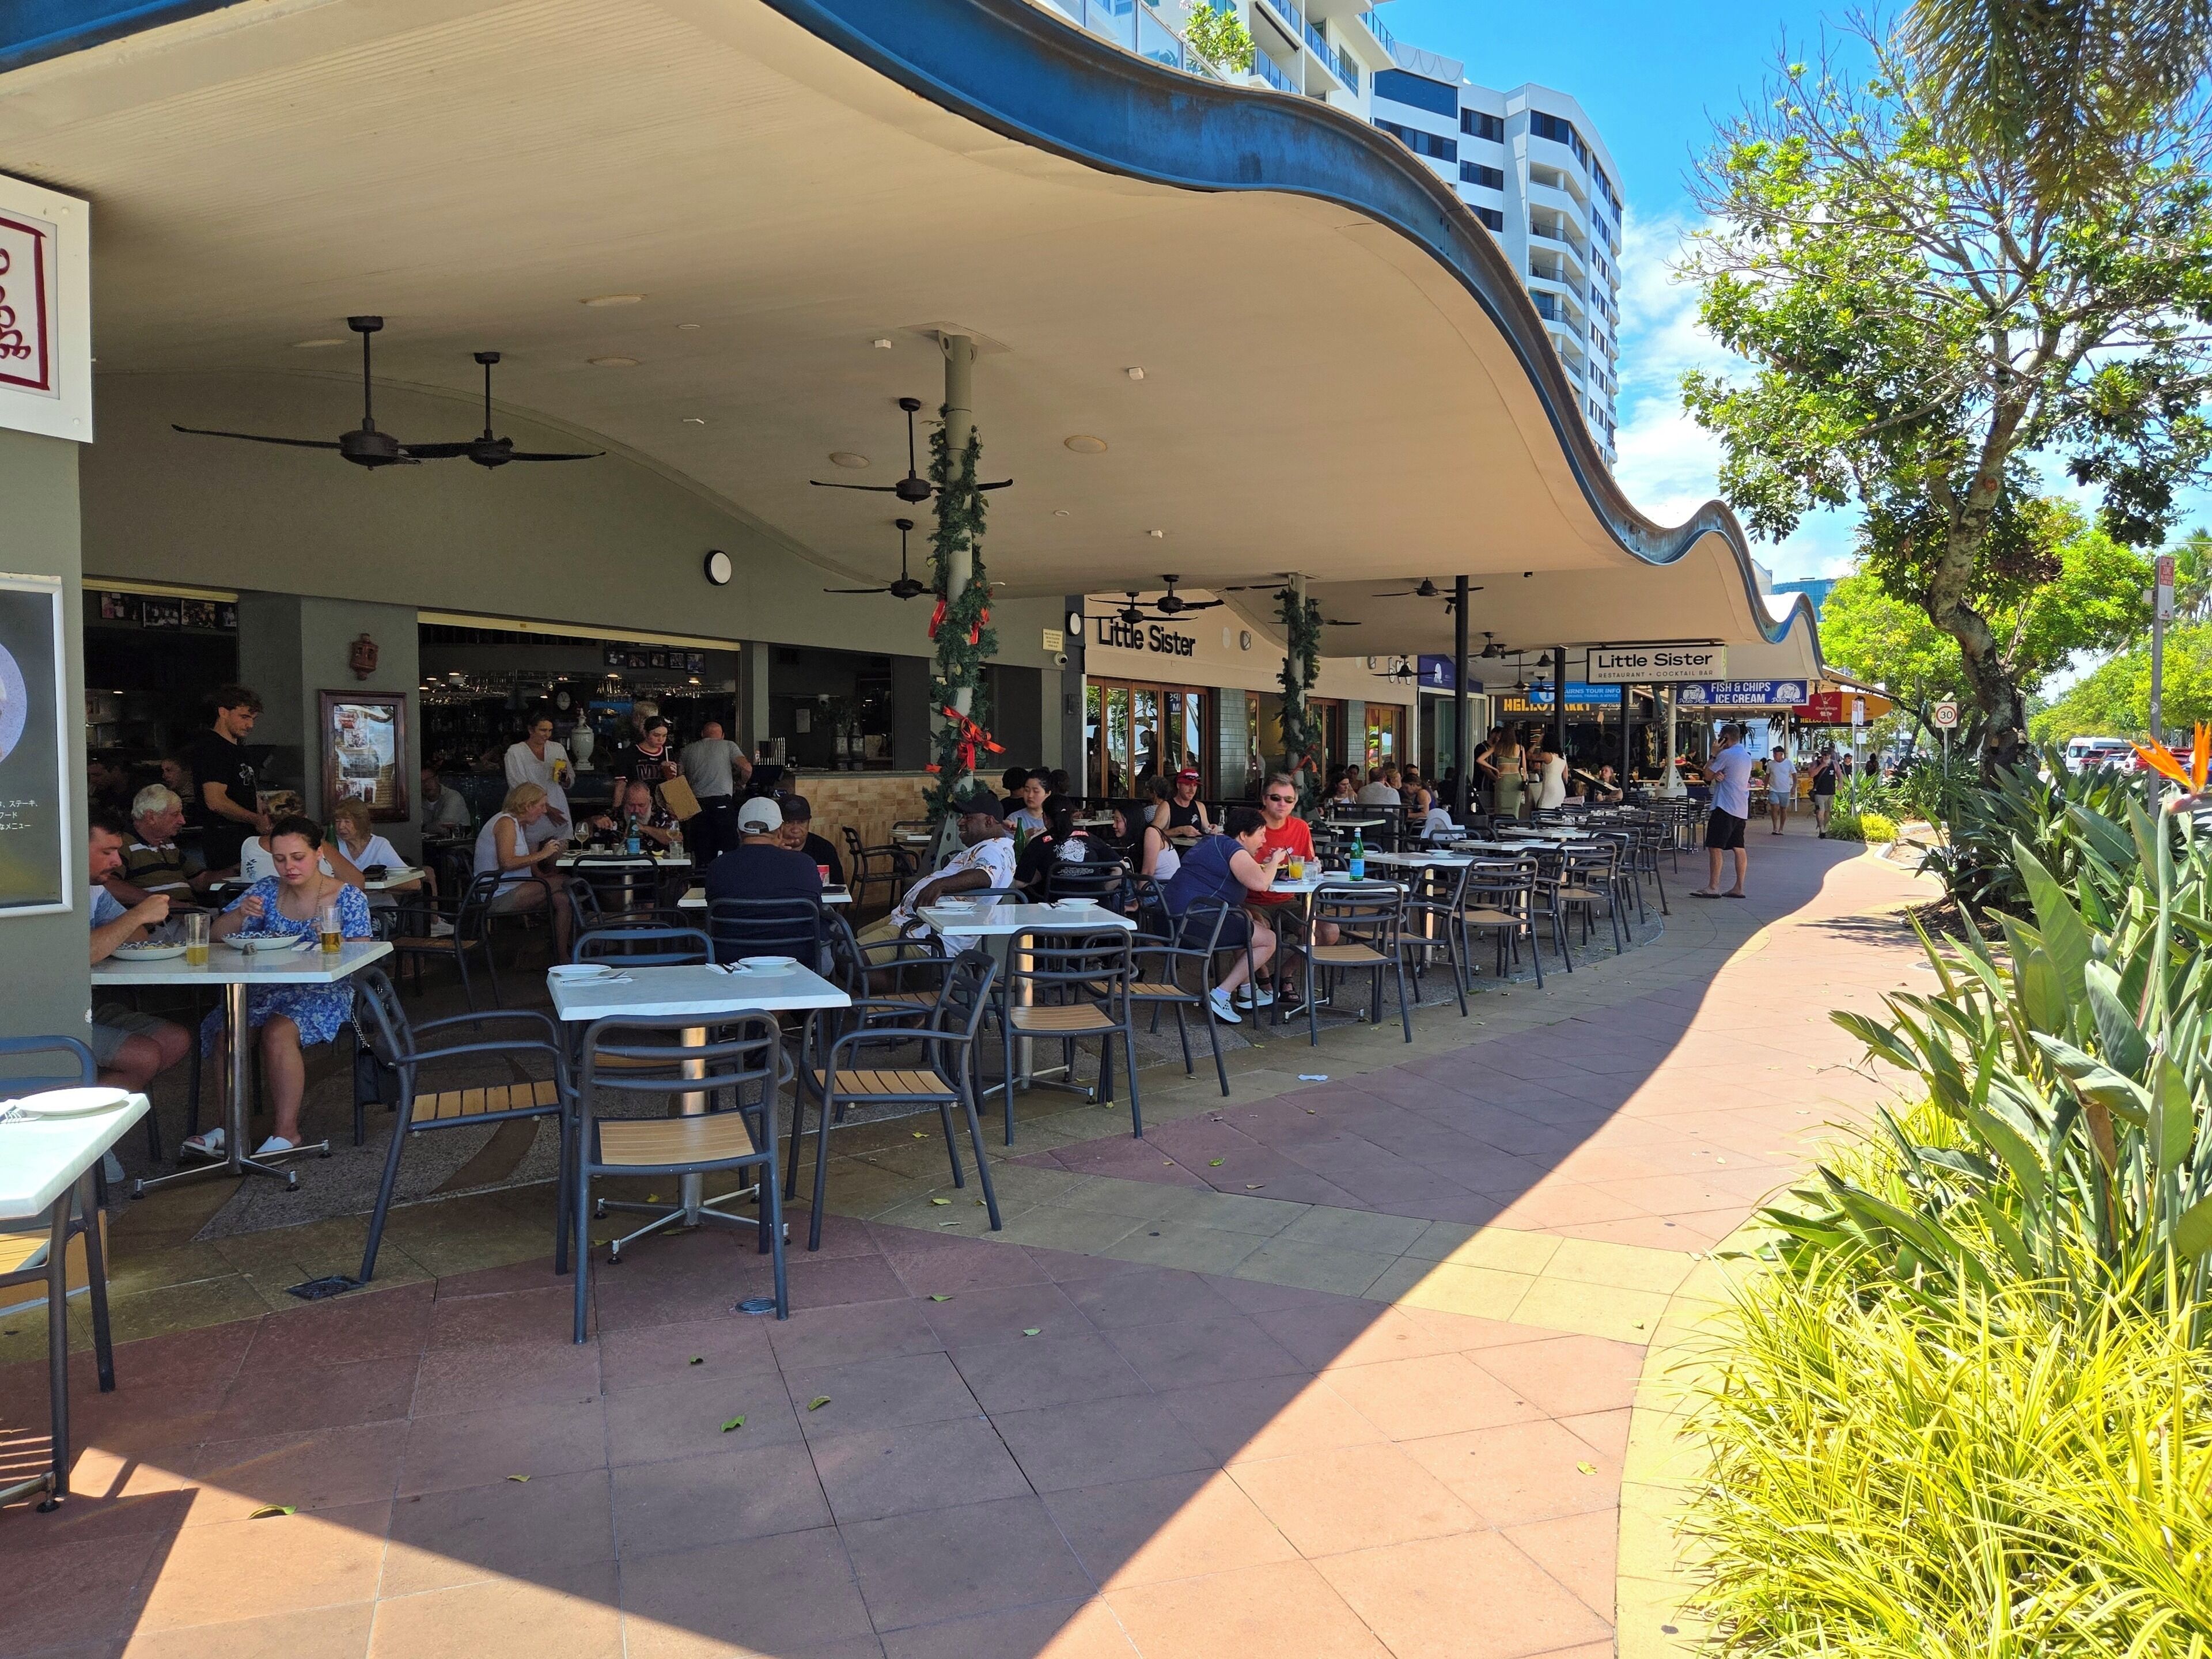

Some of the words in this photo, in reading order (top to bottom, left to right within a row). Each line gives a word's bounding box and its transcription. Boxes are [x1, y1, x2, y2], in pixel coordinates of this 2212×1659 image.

[1099, 618, 1144, 650] Little
[1148, 625, 1196, 657] Sister
[1598, 654, 1647, 668] Little
[1654, 653, 1713, 666] Sister
[1711, 682, 1732, 692] FISH
[1734, 682, 1740, 692] &
[1743, 682, 1771, 692] CHIPS
[1715, 694, 1730, 703] ICE
[1733, 694, 1766, 703] CREAM
[1940, 711, 1953, 719] 30
